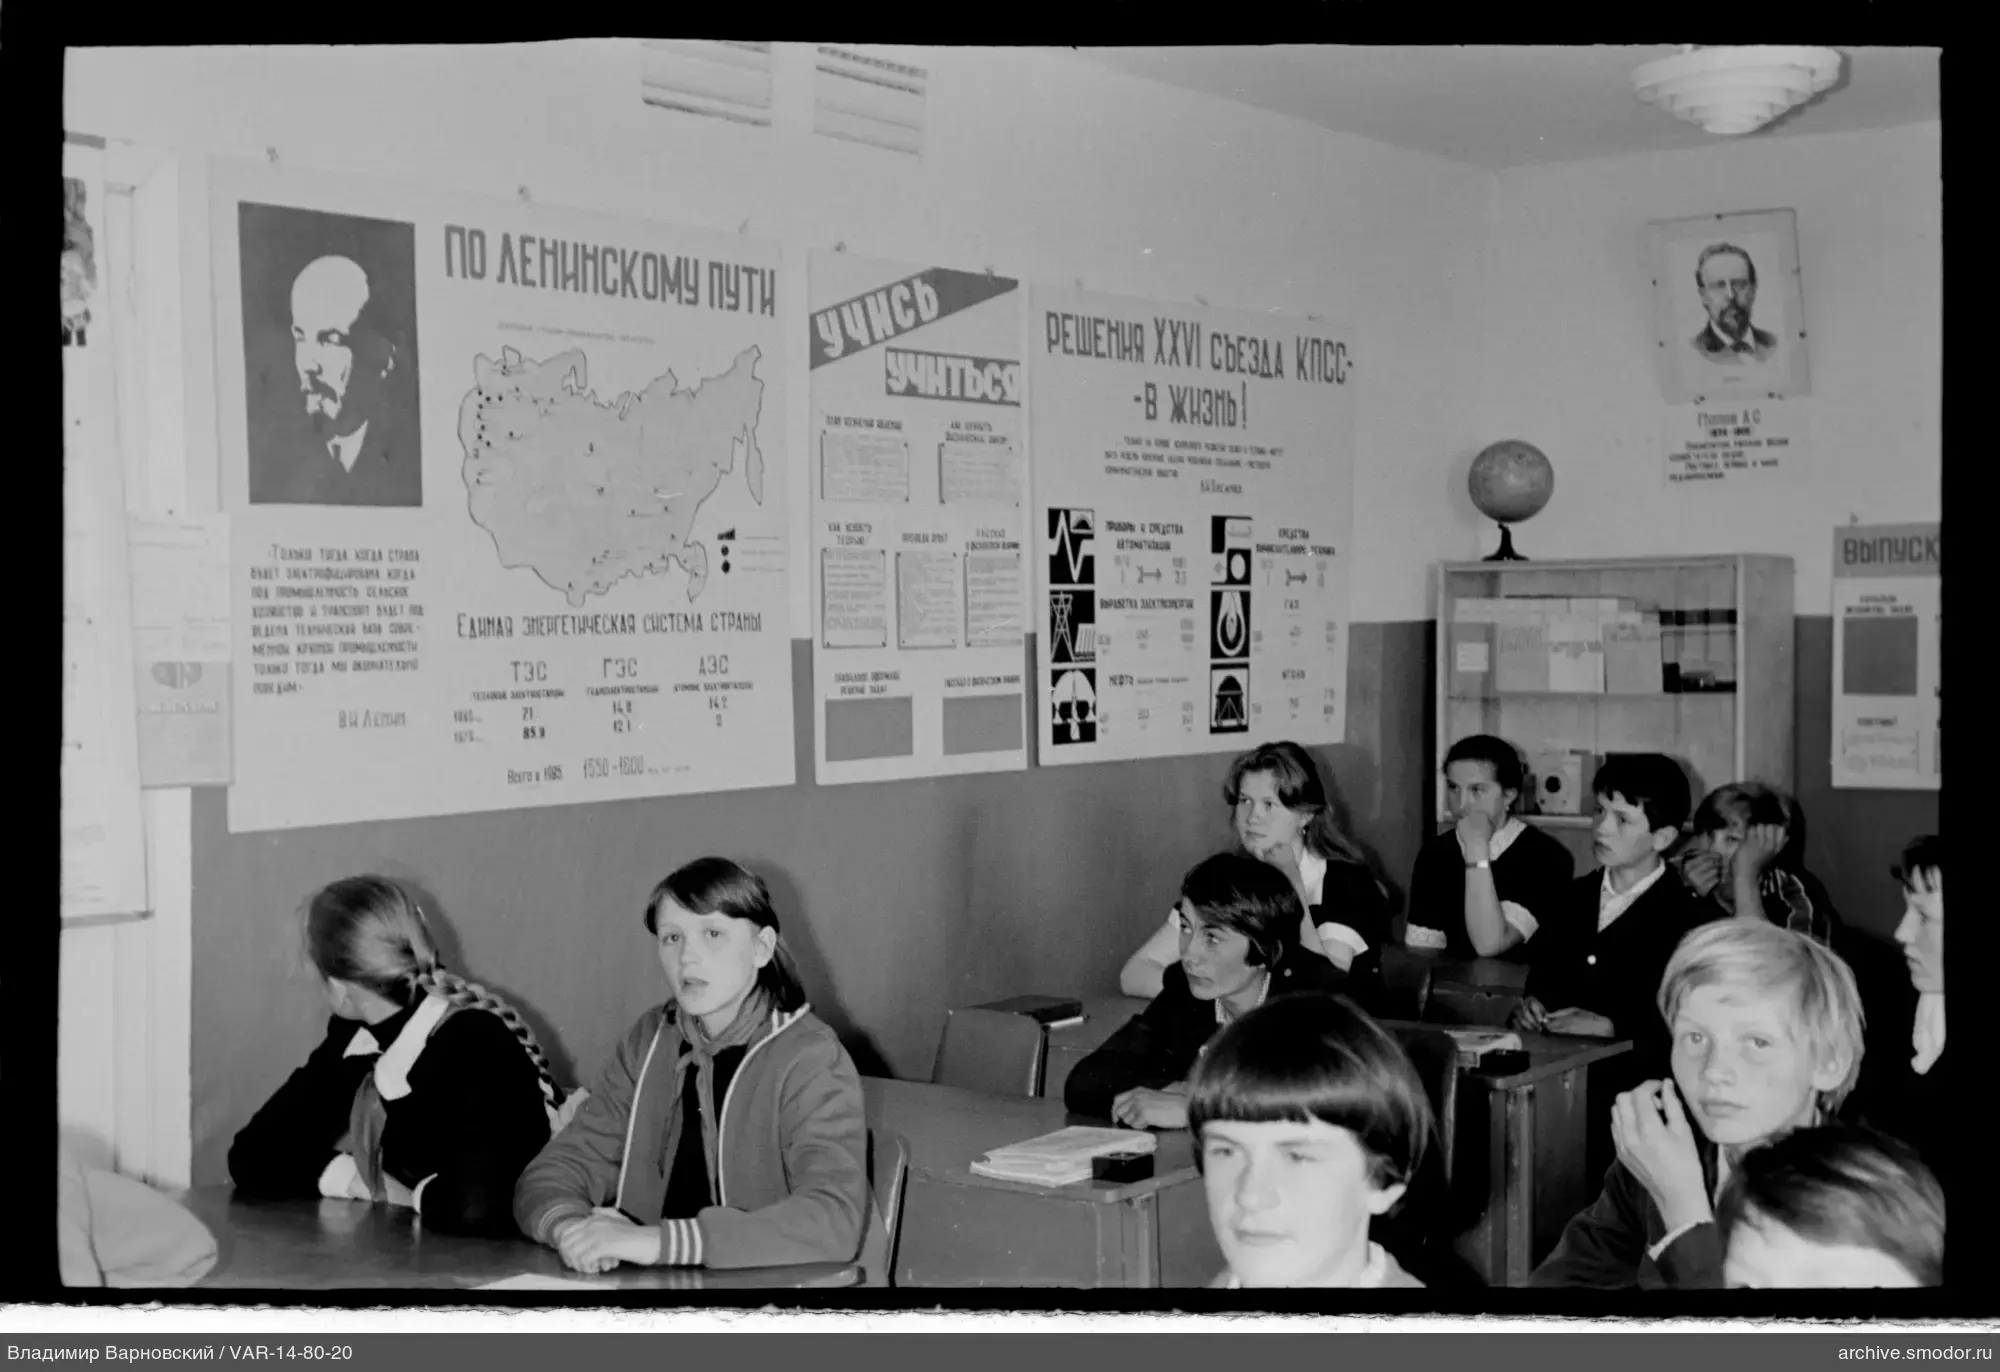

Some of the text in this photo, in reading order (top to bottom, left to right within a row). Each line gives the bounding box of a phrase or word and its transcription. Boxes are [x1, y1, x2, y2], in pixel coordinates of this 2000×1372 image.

[444, 222, 776, 318] ПО ЛЕНИНСКОМУ ПУТИ
[816, 276, 940, 359] УЧИСЬ
[1046, 310, 1145, 364] РЕШЕНИЯ
[1210, 331, 1285, 380] СЪЕЗДА
[886, 350, 1020, 402] УЧИТЬСЯ
[1168, 380, 1248, 430] ЖИЗНЬ!
[521, 612, 636, 637] ЭНЕРГЕТИЧЕСКАЯ
[643, 611, 704, 635] СИСТЕМА
[710, 610, 763, 634] СТРАНЫ
[509, 654, 730, 684] ТЭС ГЭС АЭС
